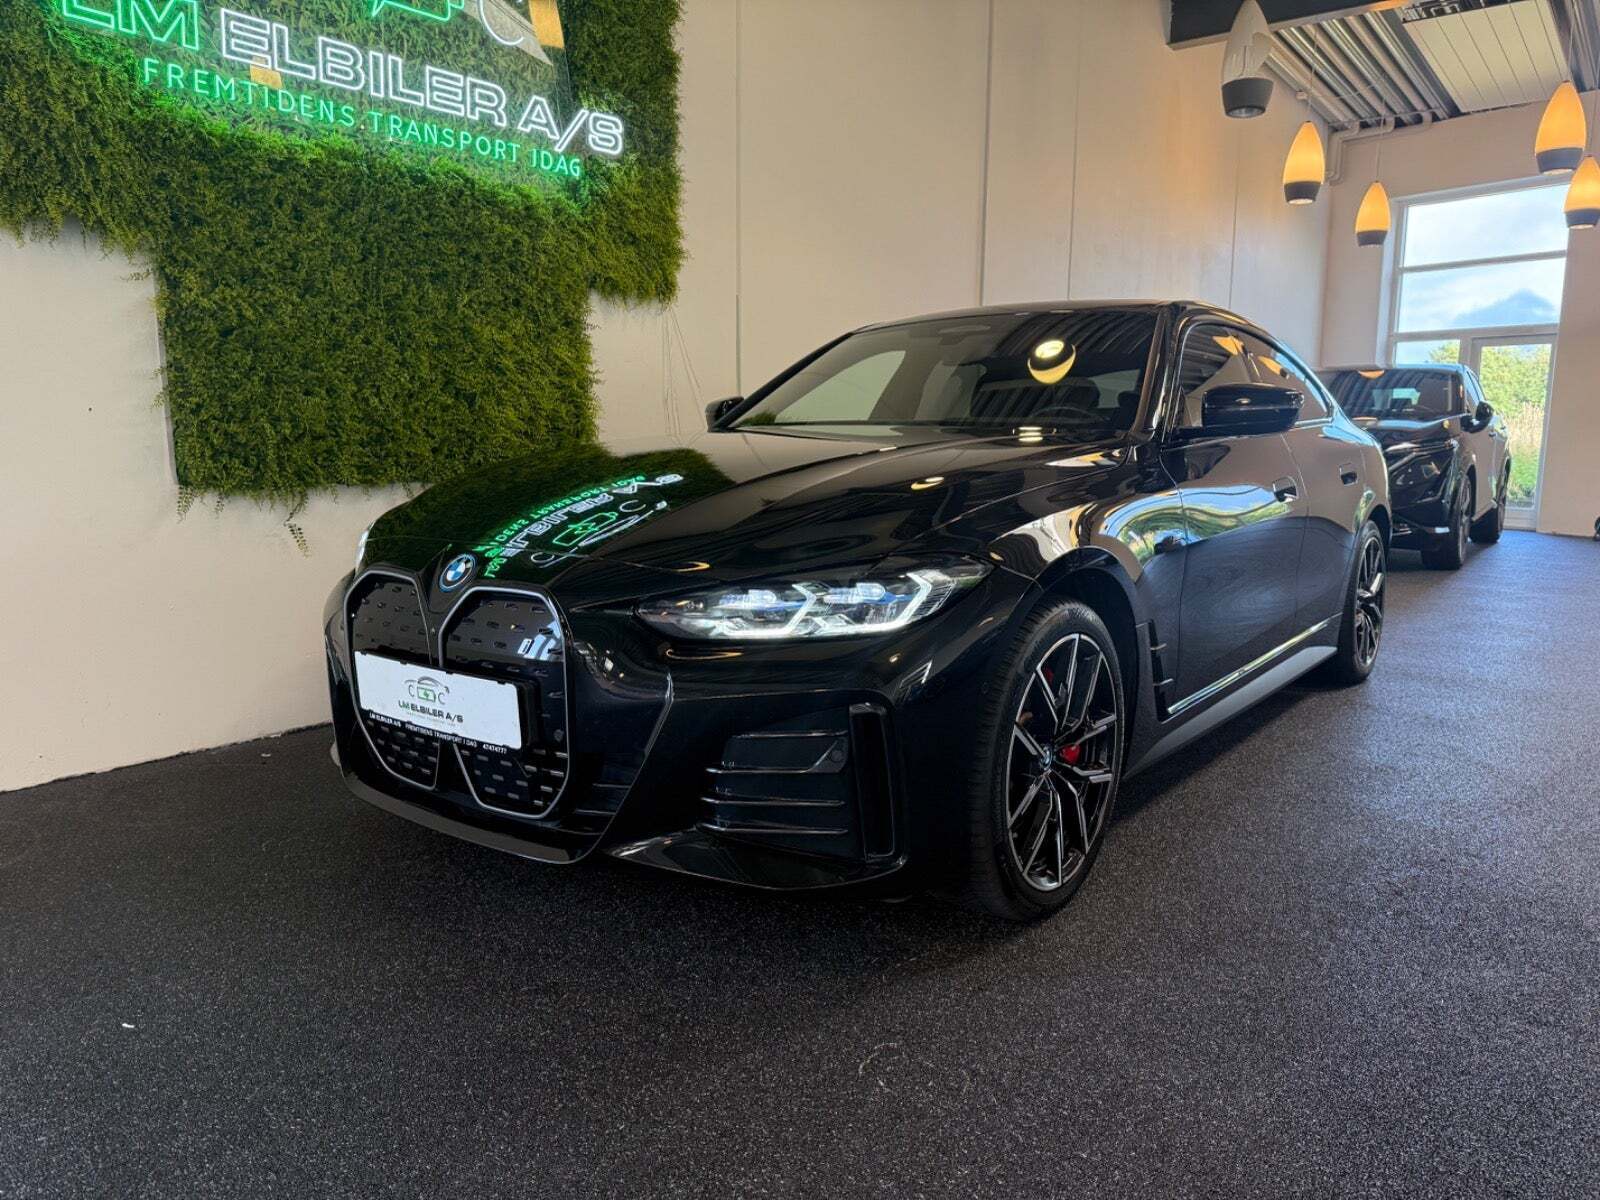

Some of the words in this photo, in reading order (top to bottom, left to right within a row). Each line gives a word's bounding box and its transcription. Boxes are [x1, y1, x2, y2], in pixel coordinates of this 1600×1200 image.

[143, 57, 355, 127] FREMTIDENS
[367, 111, 521, 163] TRANSPORT
[220, 7, 507, 128] ELBILER
[517, 94, 624, 156] A/S
[411, 703, 444, 718] ELBILER
[446, 712, 464, 723] A/S
